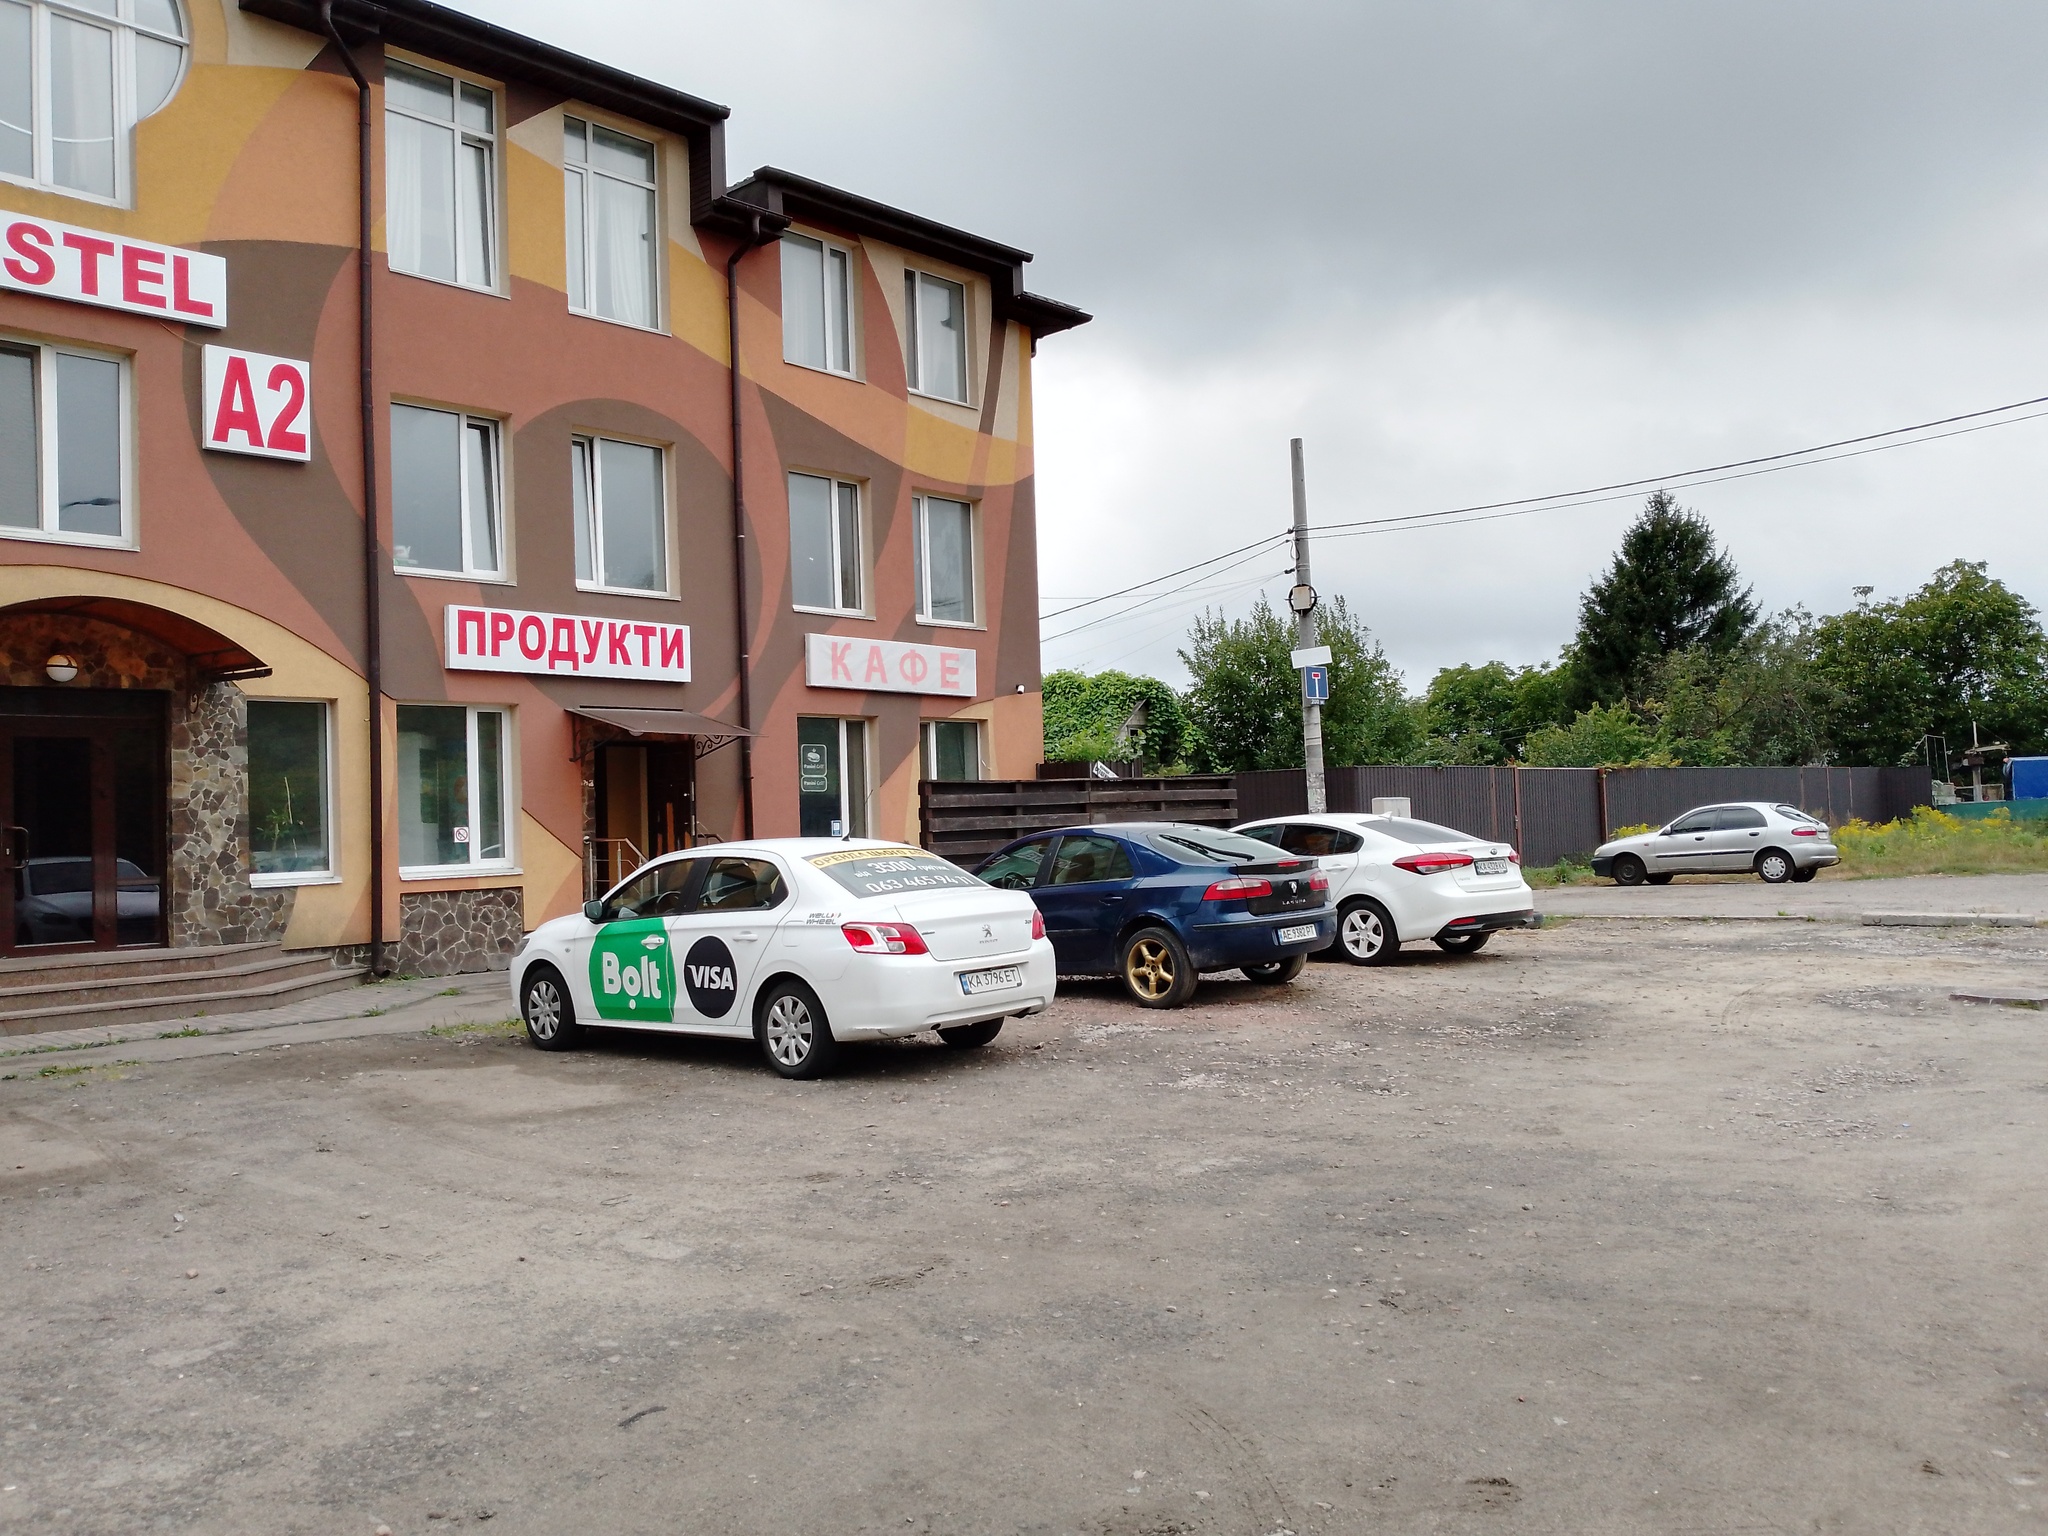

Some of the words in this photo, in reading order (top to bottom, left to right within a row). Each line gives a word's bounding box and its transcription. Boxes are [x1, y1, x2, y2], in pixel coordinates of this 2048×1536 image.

[3, 222, 214, 318] STEL
[212, 355, 307, 454] A2
[457, 609, 685, 671] ПРОДУКТИ
[831, 641, 961, 689] КАФЕ
[814, 852, 864, 866] ОРЕНДА
[866, 850, 907, 858] ЦЬОГО
[854, 870, 871, 878] від
[867, 860, 917, 874] 3500
[865, 878, 904, 894] 063
[904, 876, 935, 888] 465
[936, 875, 956, 884] 94
[602, 952, 662, 1009] Bolt
[687, 964, 734, 991] VISA
[968, 974, 982, 988] KA
[983, 971, 1004, 986] 3796
[1004, 969, 1017, 982] ET
